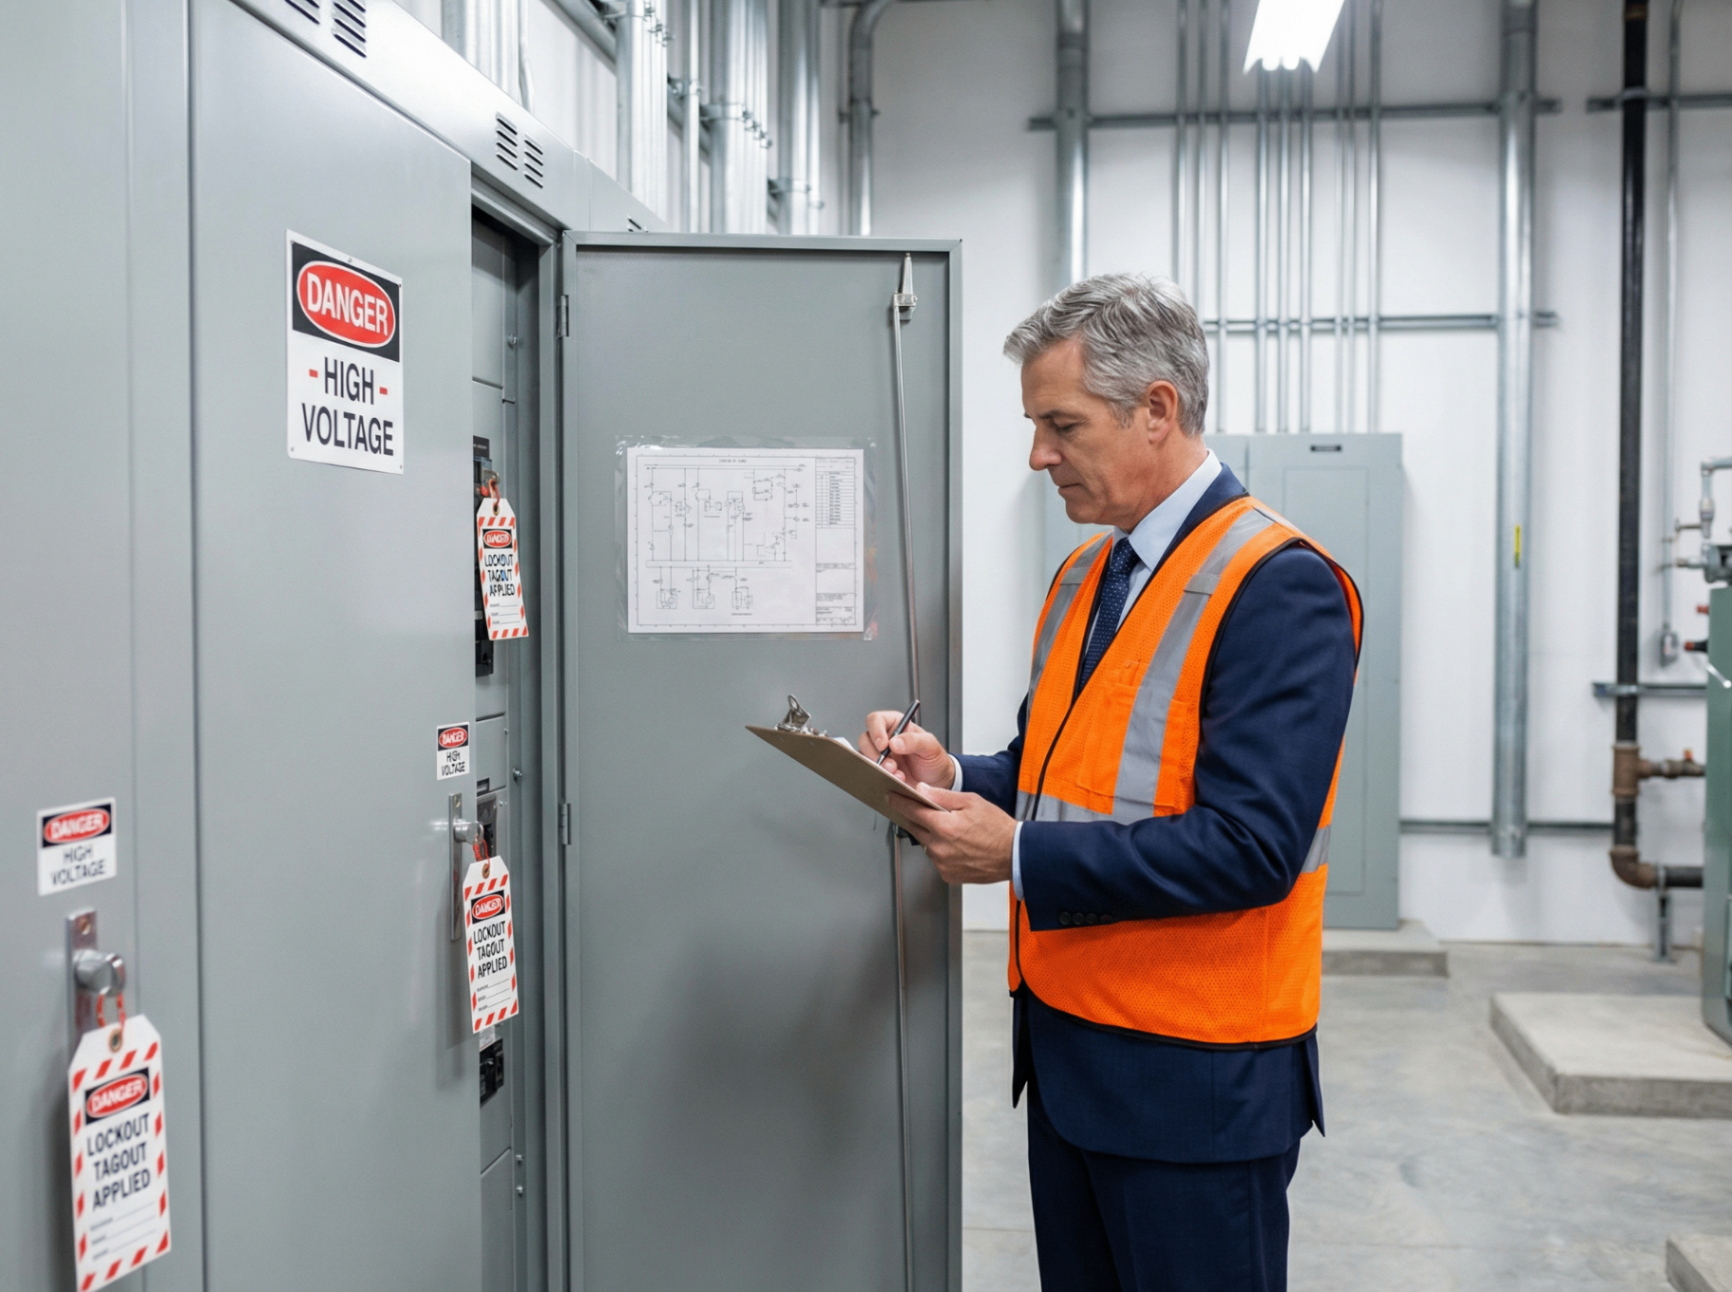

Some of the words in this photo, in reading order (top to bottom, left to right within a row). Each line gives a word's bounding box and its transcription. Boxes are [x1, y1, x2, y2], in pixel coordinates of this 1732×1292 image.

[307, 272, 388, 336] DANGER
[302, 402, 394, 456] VOLTAGE
[51, 812, 104, 840] DANGER
[473, 921, 505, 945] LOCKOUT
[476, 938, 504, 960] TAGOUT
[477, 955, 507, 979] APPLIED
[90, 1079, 144, 1114] DANGER
[87, 1112, 150, 1158] LOCKOUT
[94, 1141, 147, 1182] TAGOUT
[92, 1168, 151, 1212] APPLIED
